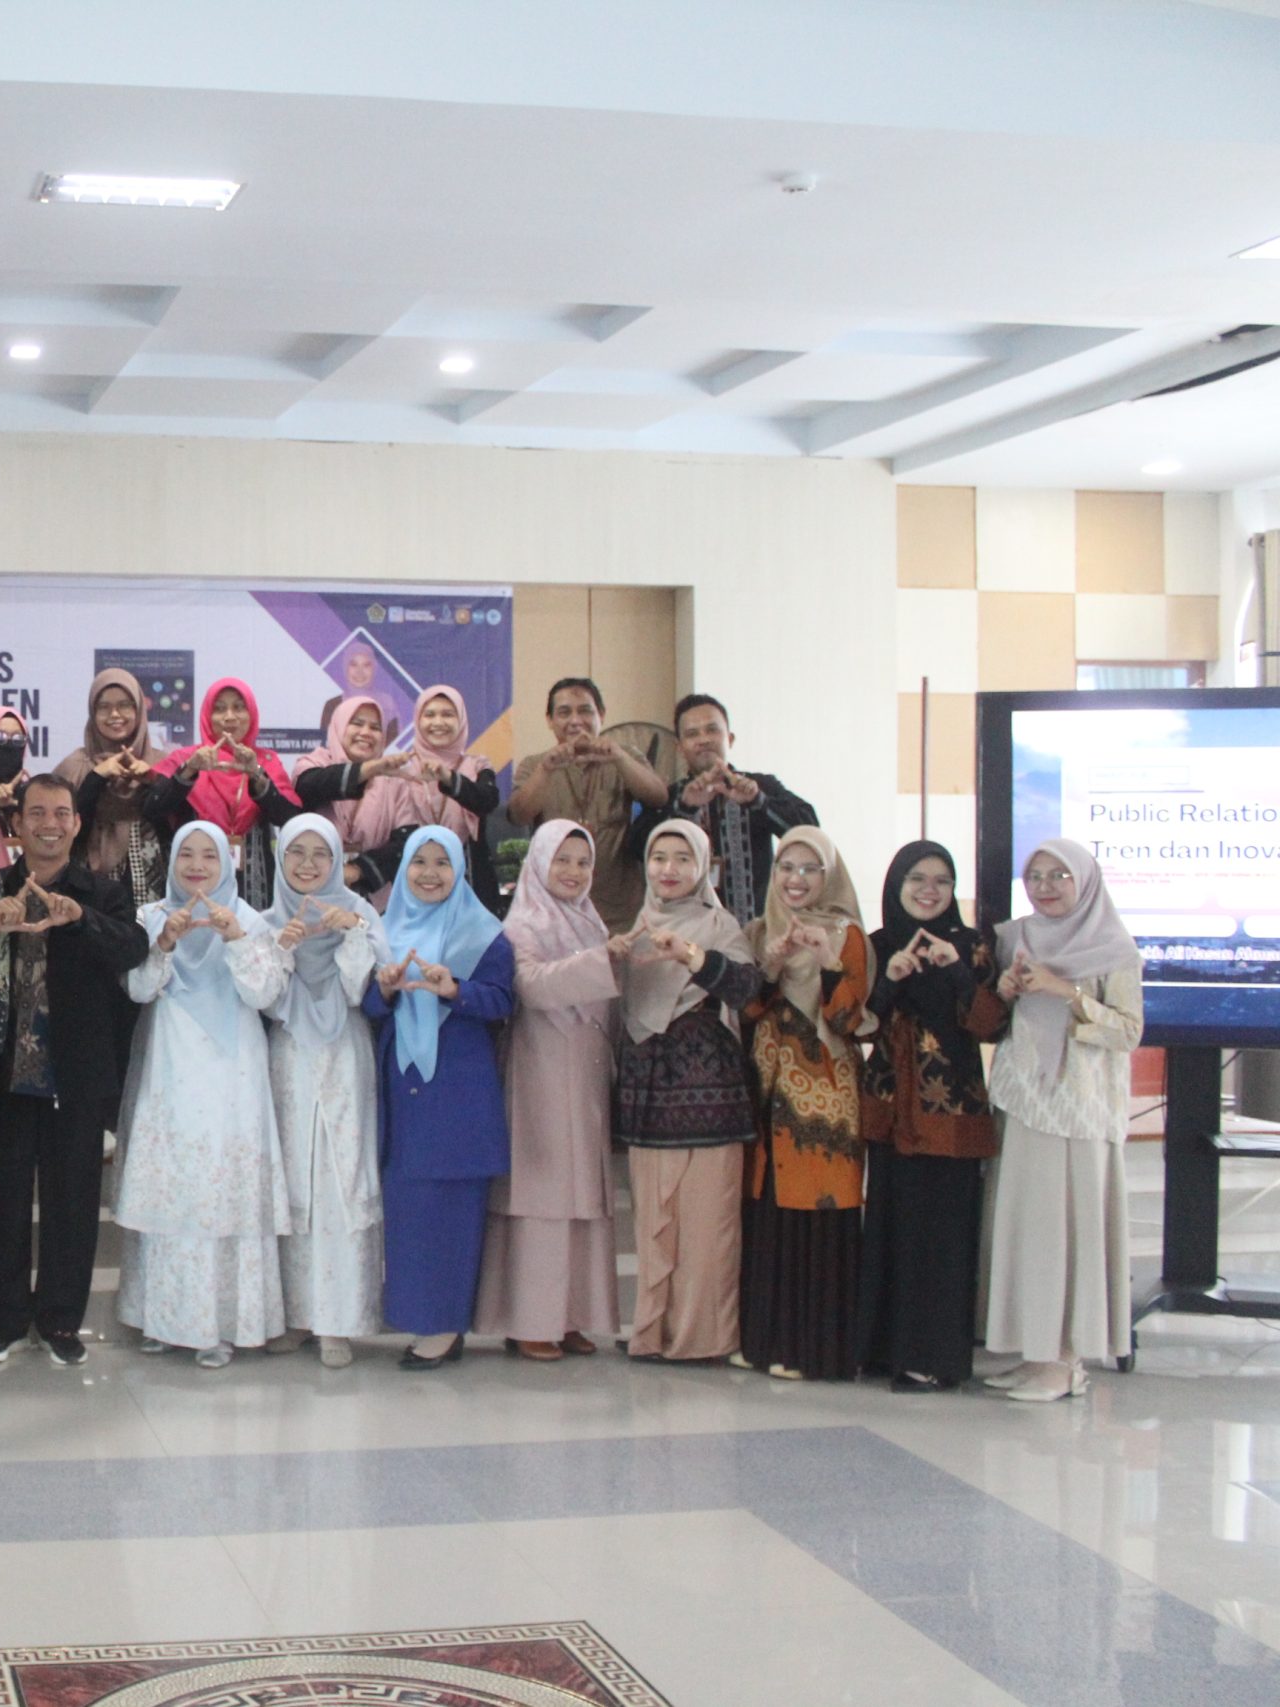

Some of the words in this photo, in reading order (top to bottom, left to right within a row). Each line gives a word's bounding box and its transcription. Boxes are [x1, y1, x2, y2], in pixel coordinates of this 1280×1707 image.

[1089, 803, 1171, 823] Public
[1179, 803, 1279, 823] Relatio
[1089, 840, 1151, 859] Tren
[1159, 839, 1210, 859] dan
